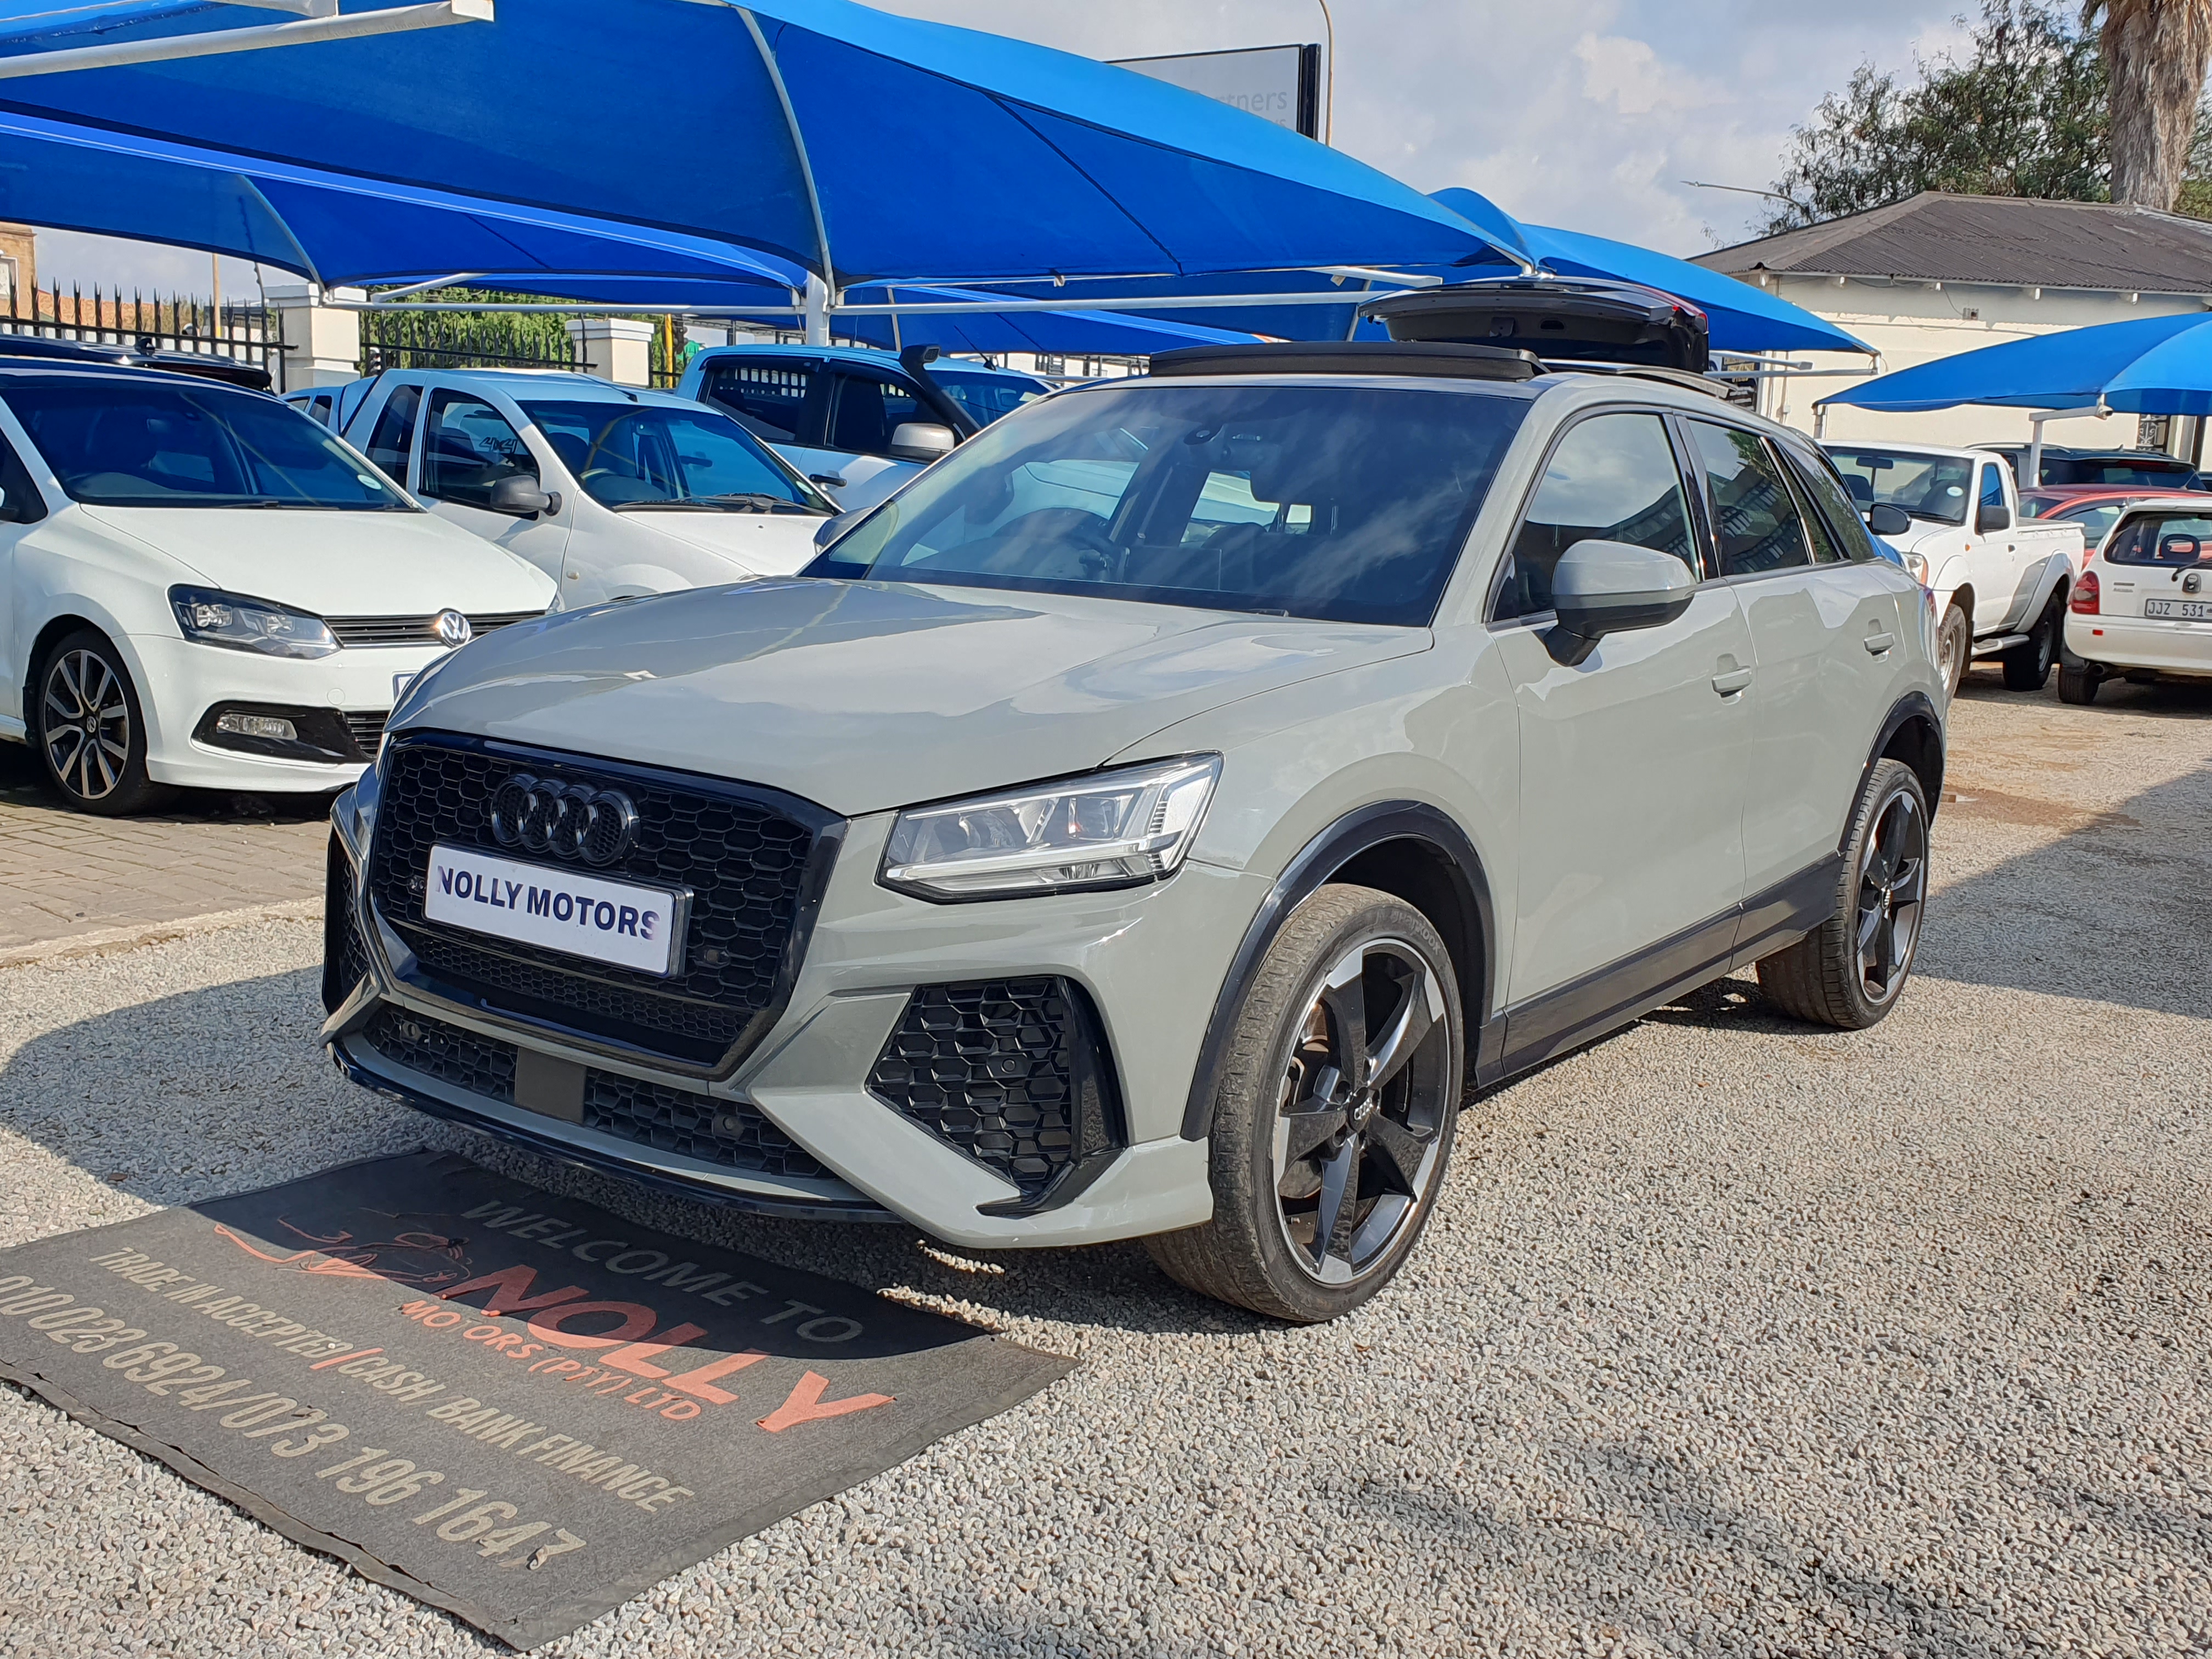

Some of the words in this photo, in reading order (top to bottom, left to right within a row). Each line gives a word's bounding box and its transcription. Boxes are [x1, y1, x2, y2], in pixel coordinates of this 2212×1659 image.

[2148, 601, 2171, 616] JJZ
[2181, 603, 2204, 617] 531
[437, 865, 524, 910] NOLLY
[526, 885, 661, 940] MOTORS
[461, 1200, 768, 1306] WELCOME
[761, 1299, 864, 1342] TO
[89, 1246, 196, 1291] TRADE
[162, 1283, 225, 1304] IN
[516, 1433, 695, 1513] FINANCE
[430, 1264, 896, 1432] NOLLY
[527, 1356, 633, 1395] (PTY)
[623, 1386, 701, 1420] LTD
[314, 1446, 445, 1505] 196
[411, 1487, 587, 1569] 1647
